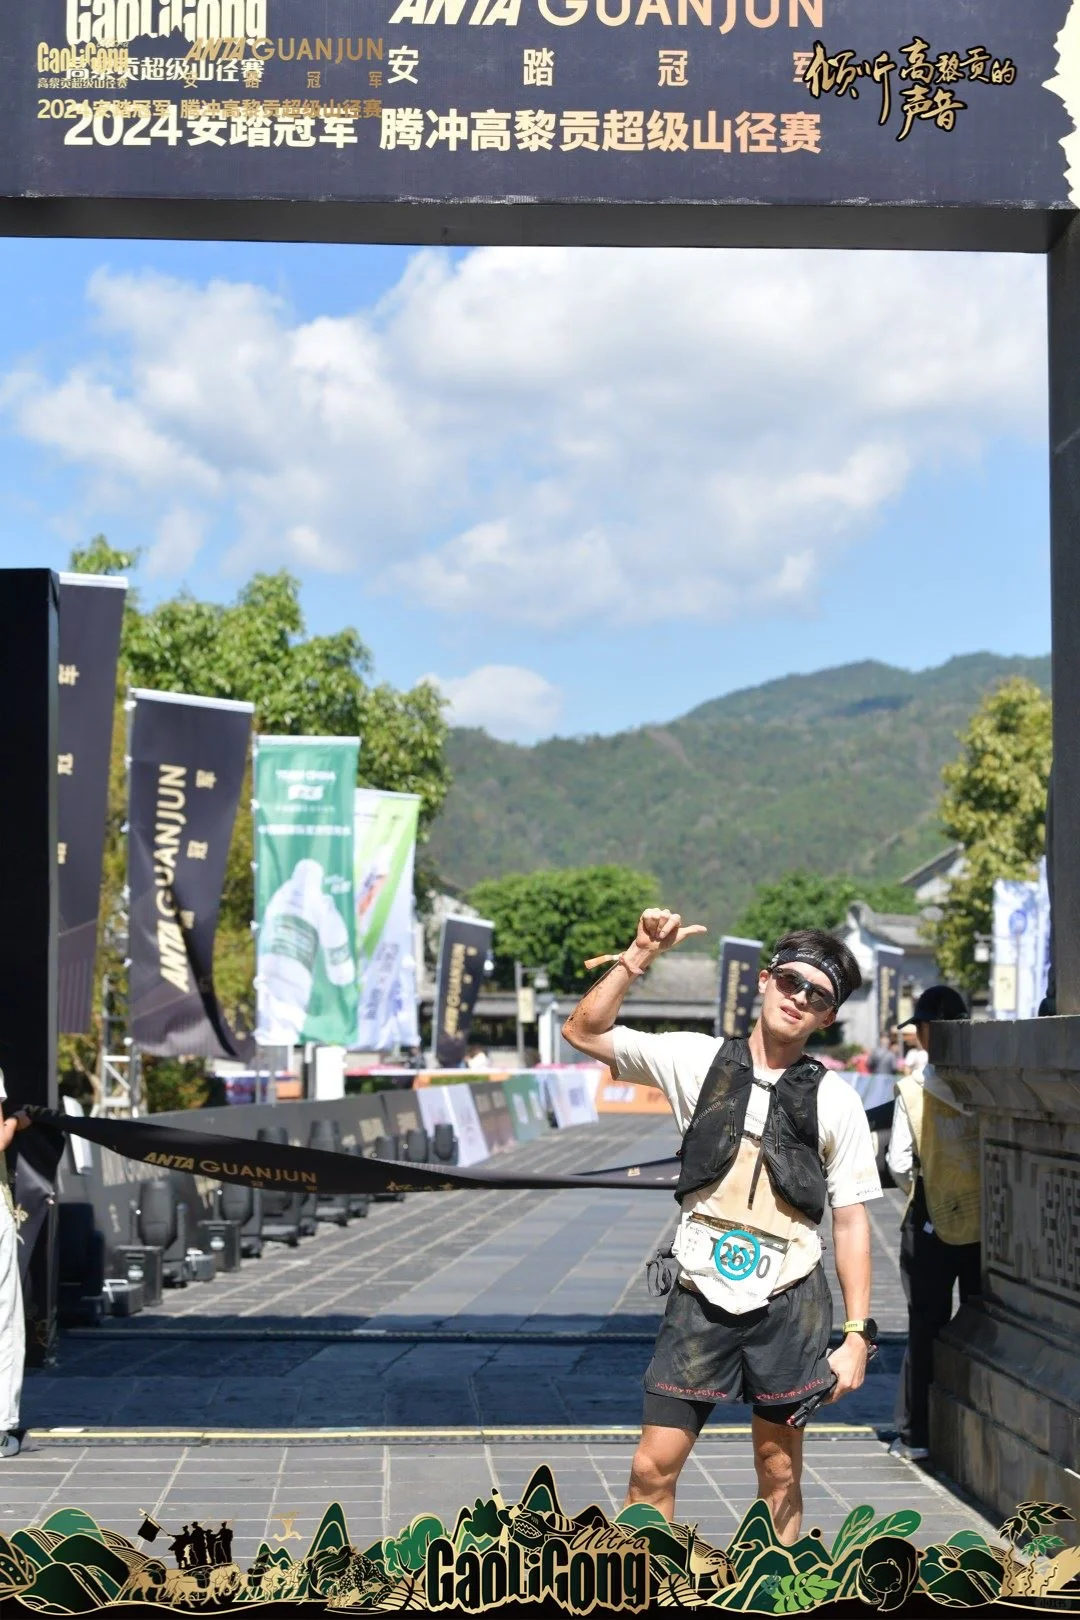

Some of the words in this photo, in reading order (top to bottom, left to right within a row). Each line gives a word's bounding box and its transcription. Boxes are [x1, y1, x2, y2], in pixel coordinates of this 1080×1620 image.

[379, 107, 822, 154] 腾冲高黎贡超级山径赛
[144, 1152, 195, 1170] ANTA
[200, 1160, 318, 1184] GUANJUN
